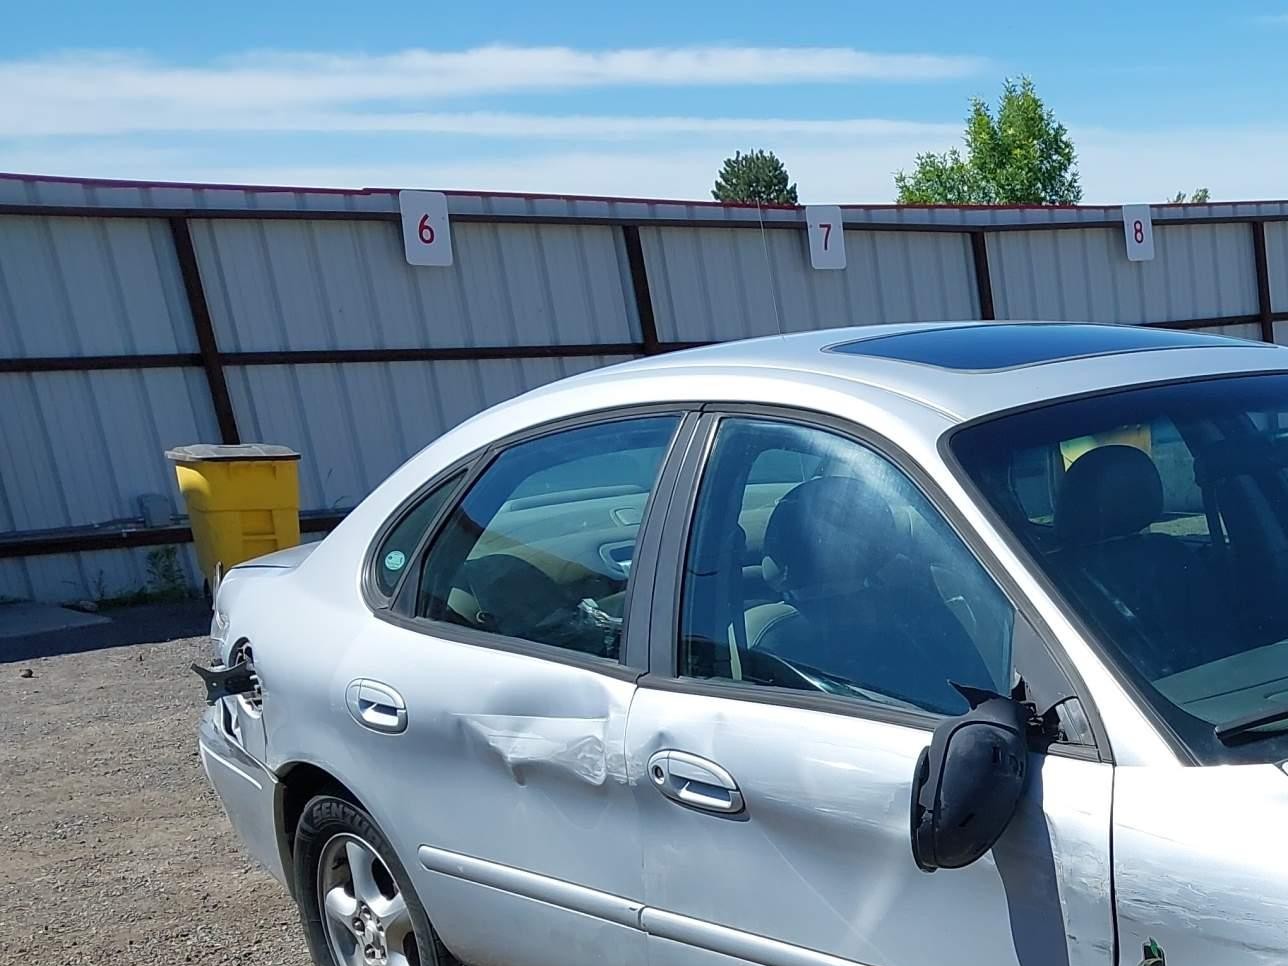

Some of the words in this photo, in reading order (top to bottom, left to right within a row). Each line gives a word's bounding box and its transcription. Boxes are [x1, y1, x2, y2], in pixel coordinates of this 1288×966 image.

[418, 214, 435, 244] 6
[819, 224, 832, 250] 7
[1133, 220, 1144, 244] 8
